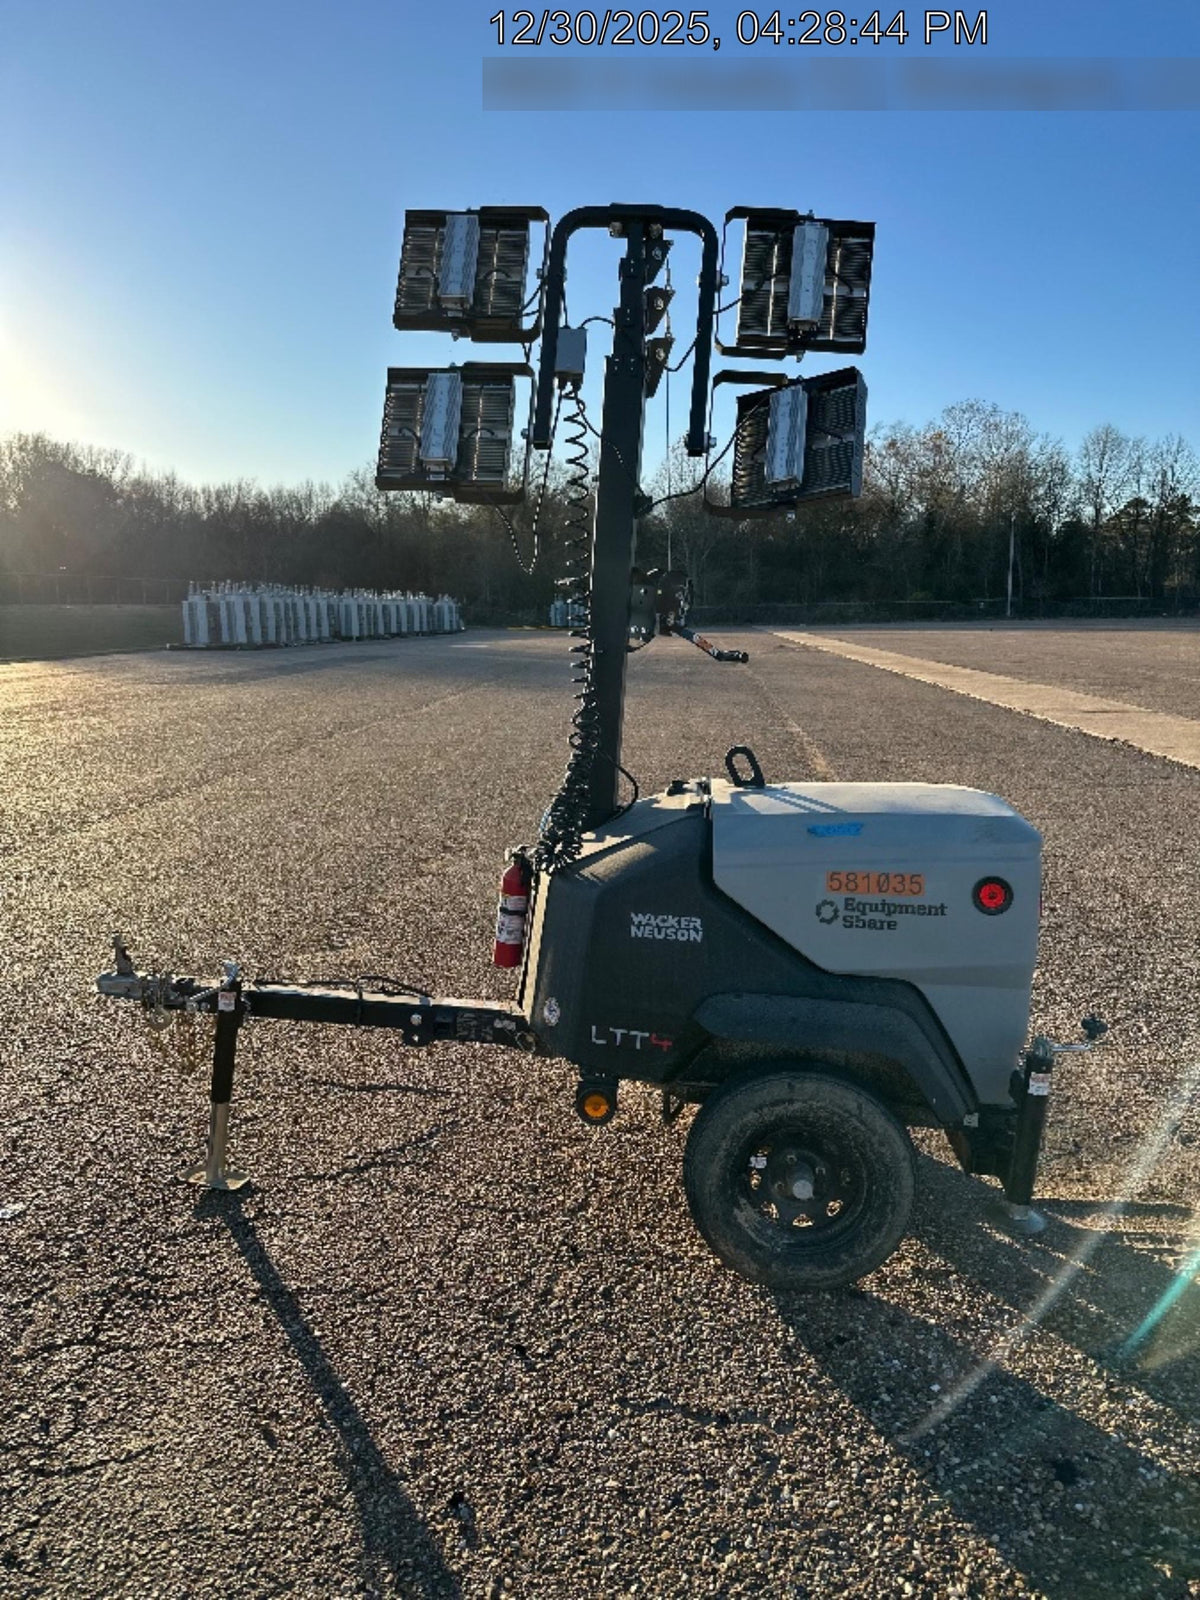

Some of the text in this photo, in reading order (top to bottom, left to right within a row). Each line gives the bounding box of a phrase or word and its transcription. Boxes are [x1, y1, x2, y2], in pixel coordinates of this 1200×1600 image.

[829, 872, 922, 895] 581035
[844, 897, 948, 917] Equipment
[630, 912, 703, 931] WACKER
[842, 915, 898, 930] Share
[630, 925, 703, 943] NEUSON
[591, 1025, 673, 1052] LTT4
